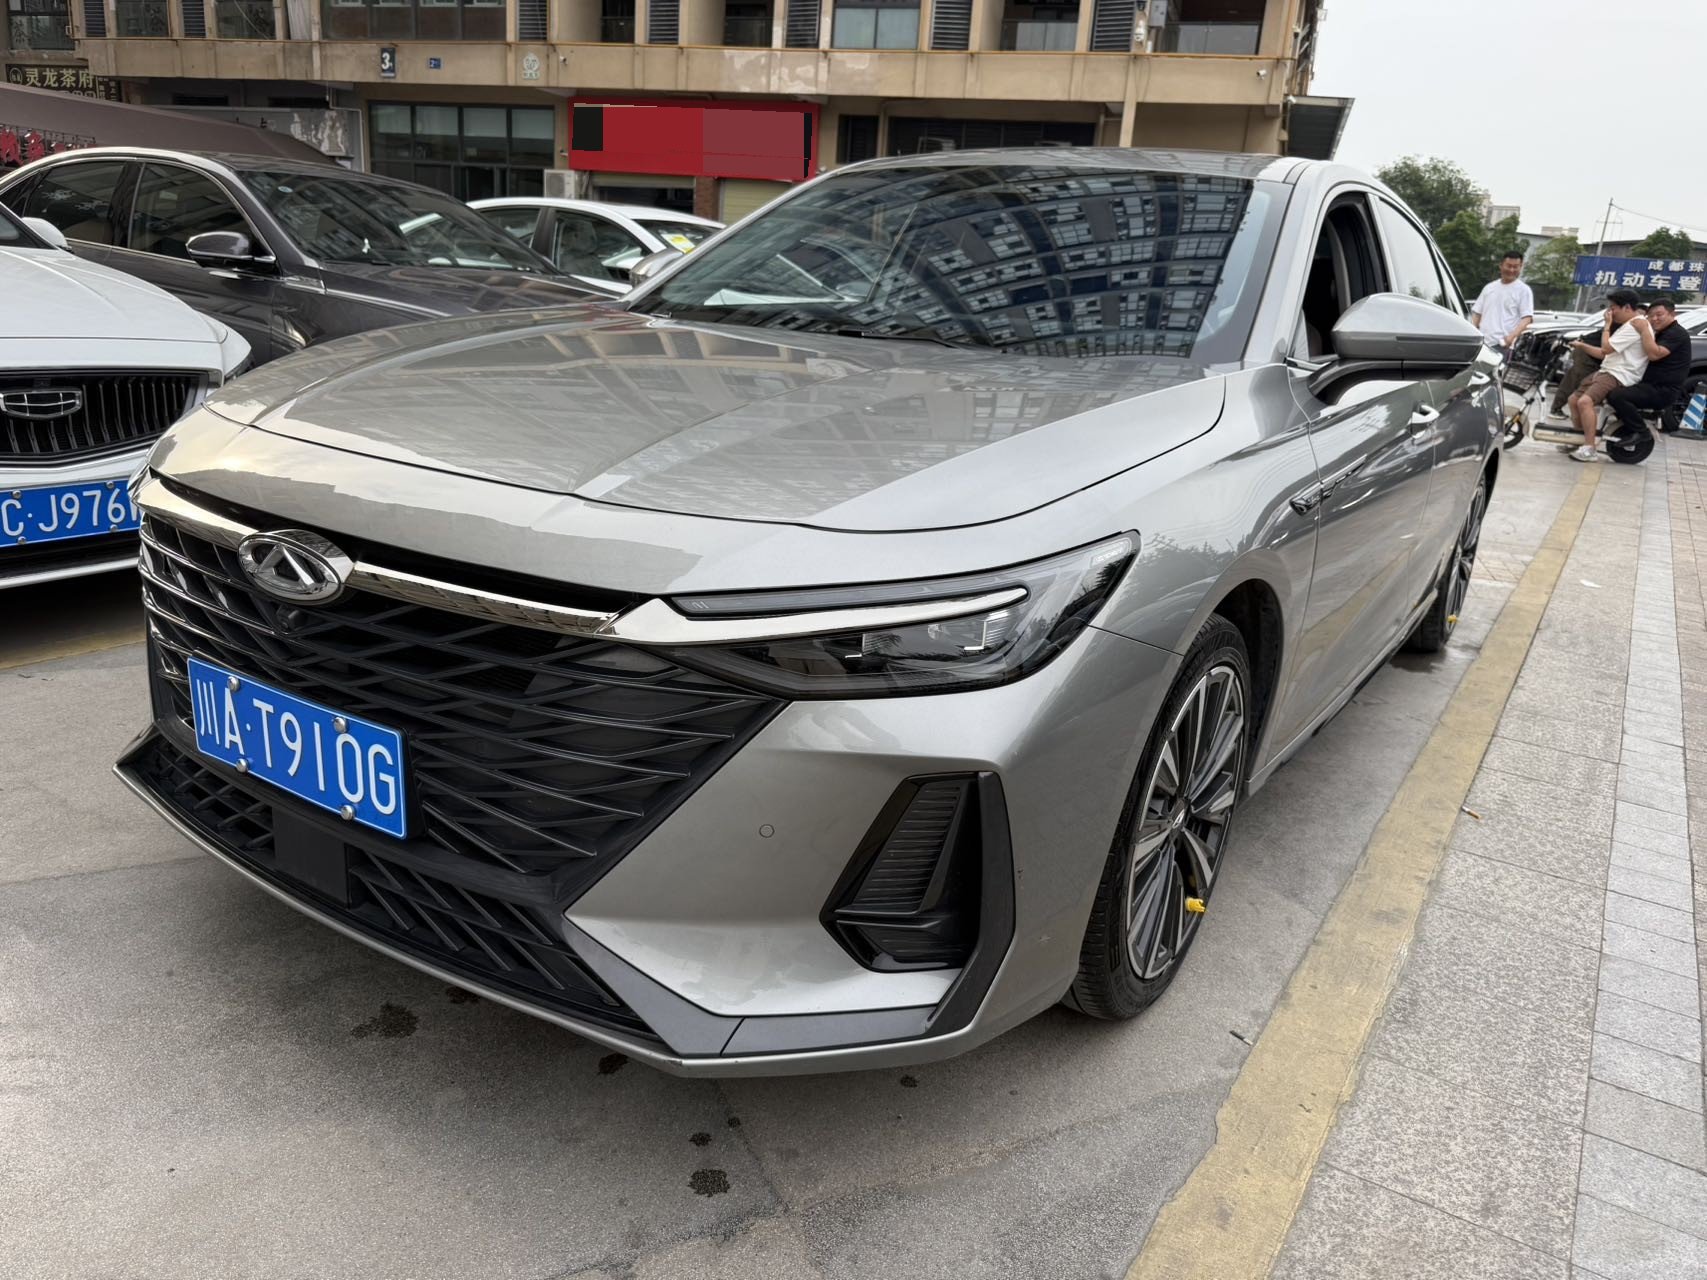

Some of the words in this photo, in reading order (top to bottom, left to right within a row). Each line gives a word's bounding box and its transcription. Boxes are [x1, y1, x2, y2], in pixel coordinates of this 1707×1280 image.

[25, 68, 94, 88] 灵龙茶府
[1595, 270, 1701, 291] 机动车登
